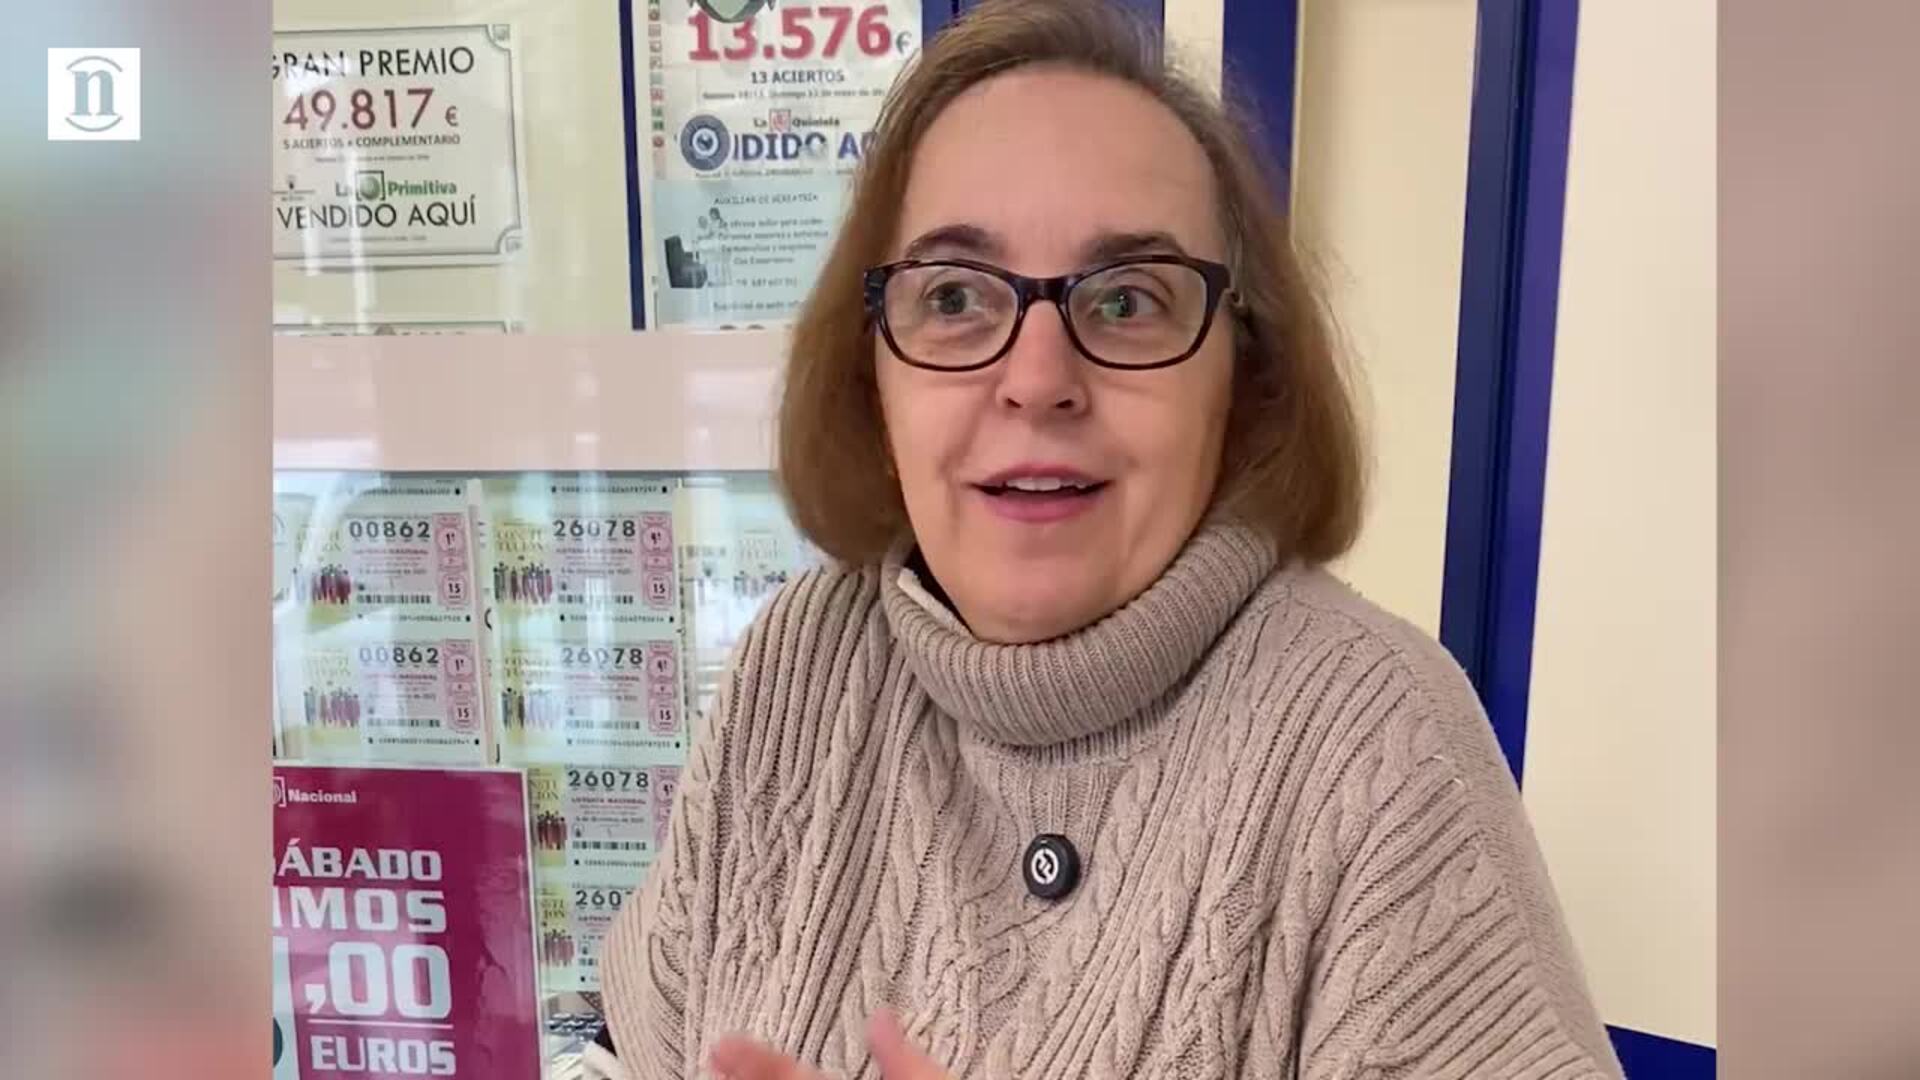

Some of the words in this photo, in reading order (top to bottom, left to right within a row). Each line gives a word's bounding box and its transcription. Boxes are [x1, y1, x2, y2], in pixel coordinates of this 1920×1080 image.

[686, 4, 892, 62] 13.576
[273, 50, 347, 79] RAN
[359, 46, 475, 77] PREMIO
[750, 70, 768, 84] 13
[771, 68, 845, 83] ACIERTOS
[283, 88, 435, 131] 49.817
[444, 105, 460, 127] €
[283, 139, 291, 151] 5
[355, 133, 461, 148] COMPLEMENTARIO
[387, 179, 457, 198] Primitiva
[276, 202, 397, 230] VENDIDO
[407, 193, 476, 227] AQUÍ
[350, 520, 431, 539] 00862
[553, 519, 636, 538] 26078
[447, 581, 461, 594] 15
[652, 582, 666, 595] 15
[359, 646, 440, 665] 00862
[562, 646, 644, 665] 26078
[456, 706, 470, 719] 15
[659, 709, 672, 721] 15
[567, 769, 650, 789] 26078
[287, 788, 358, 804] Nacional
[273, 837, 443, 882] ÁBADO
[310, 1034, 457, 1076] EUROS
